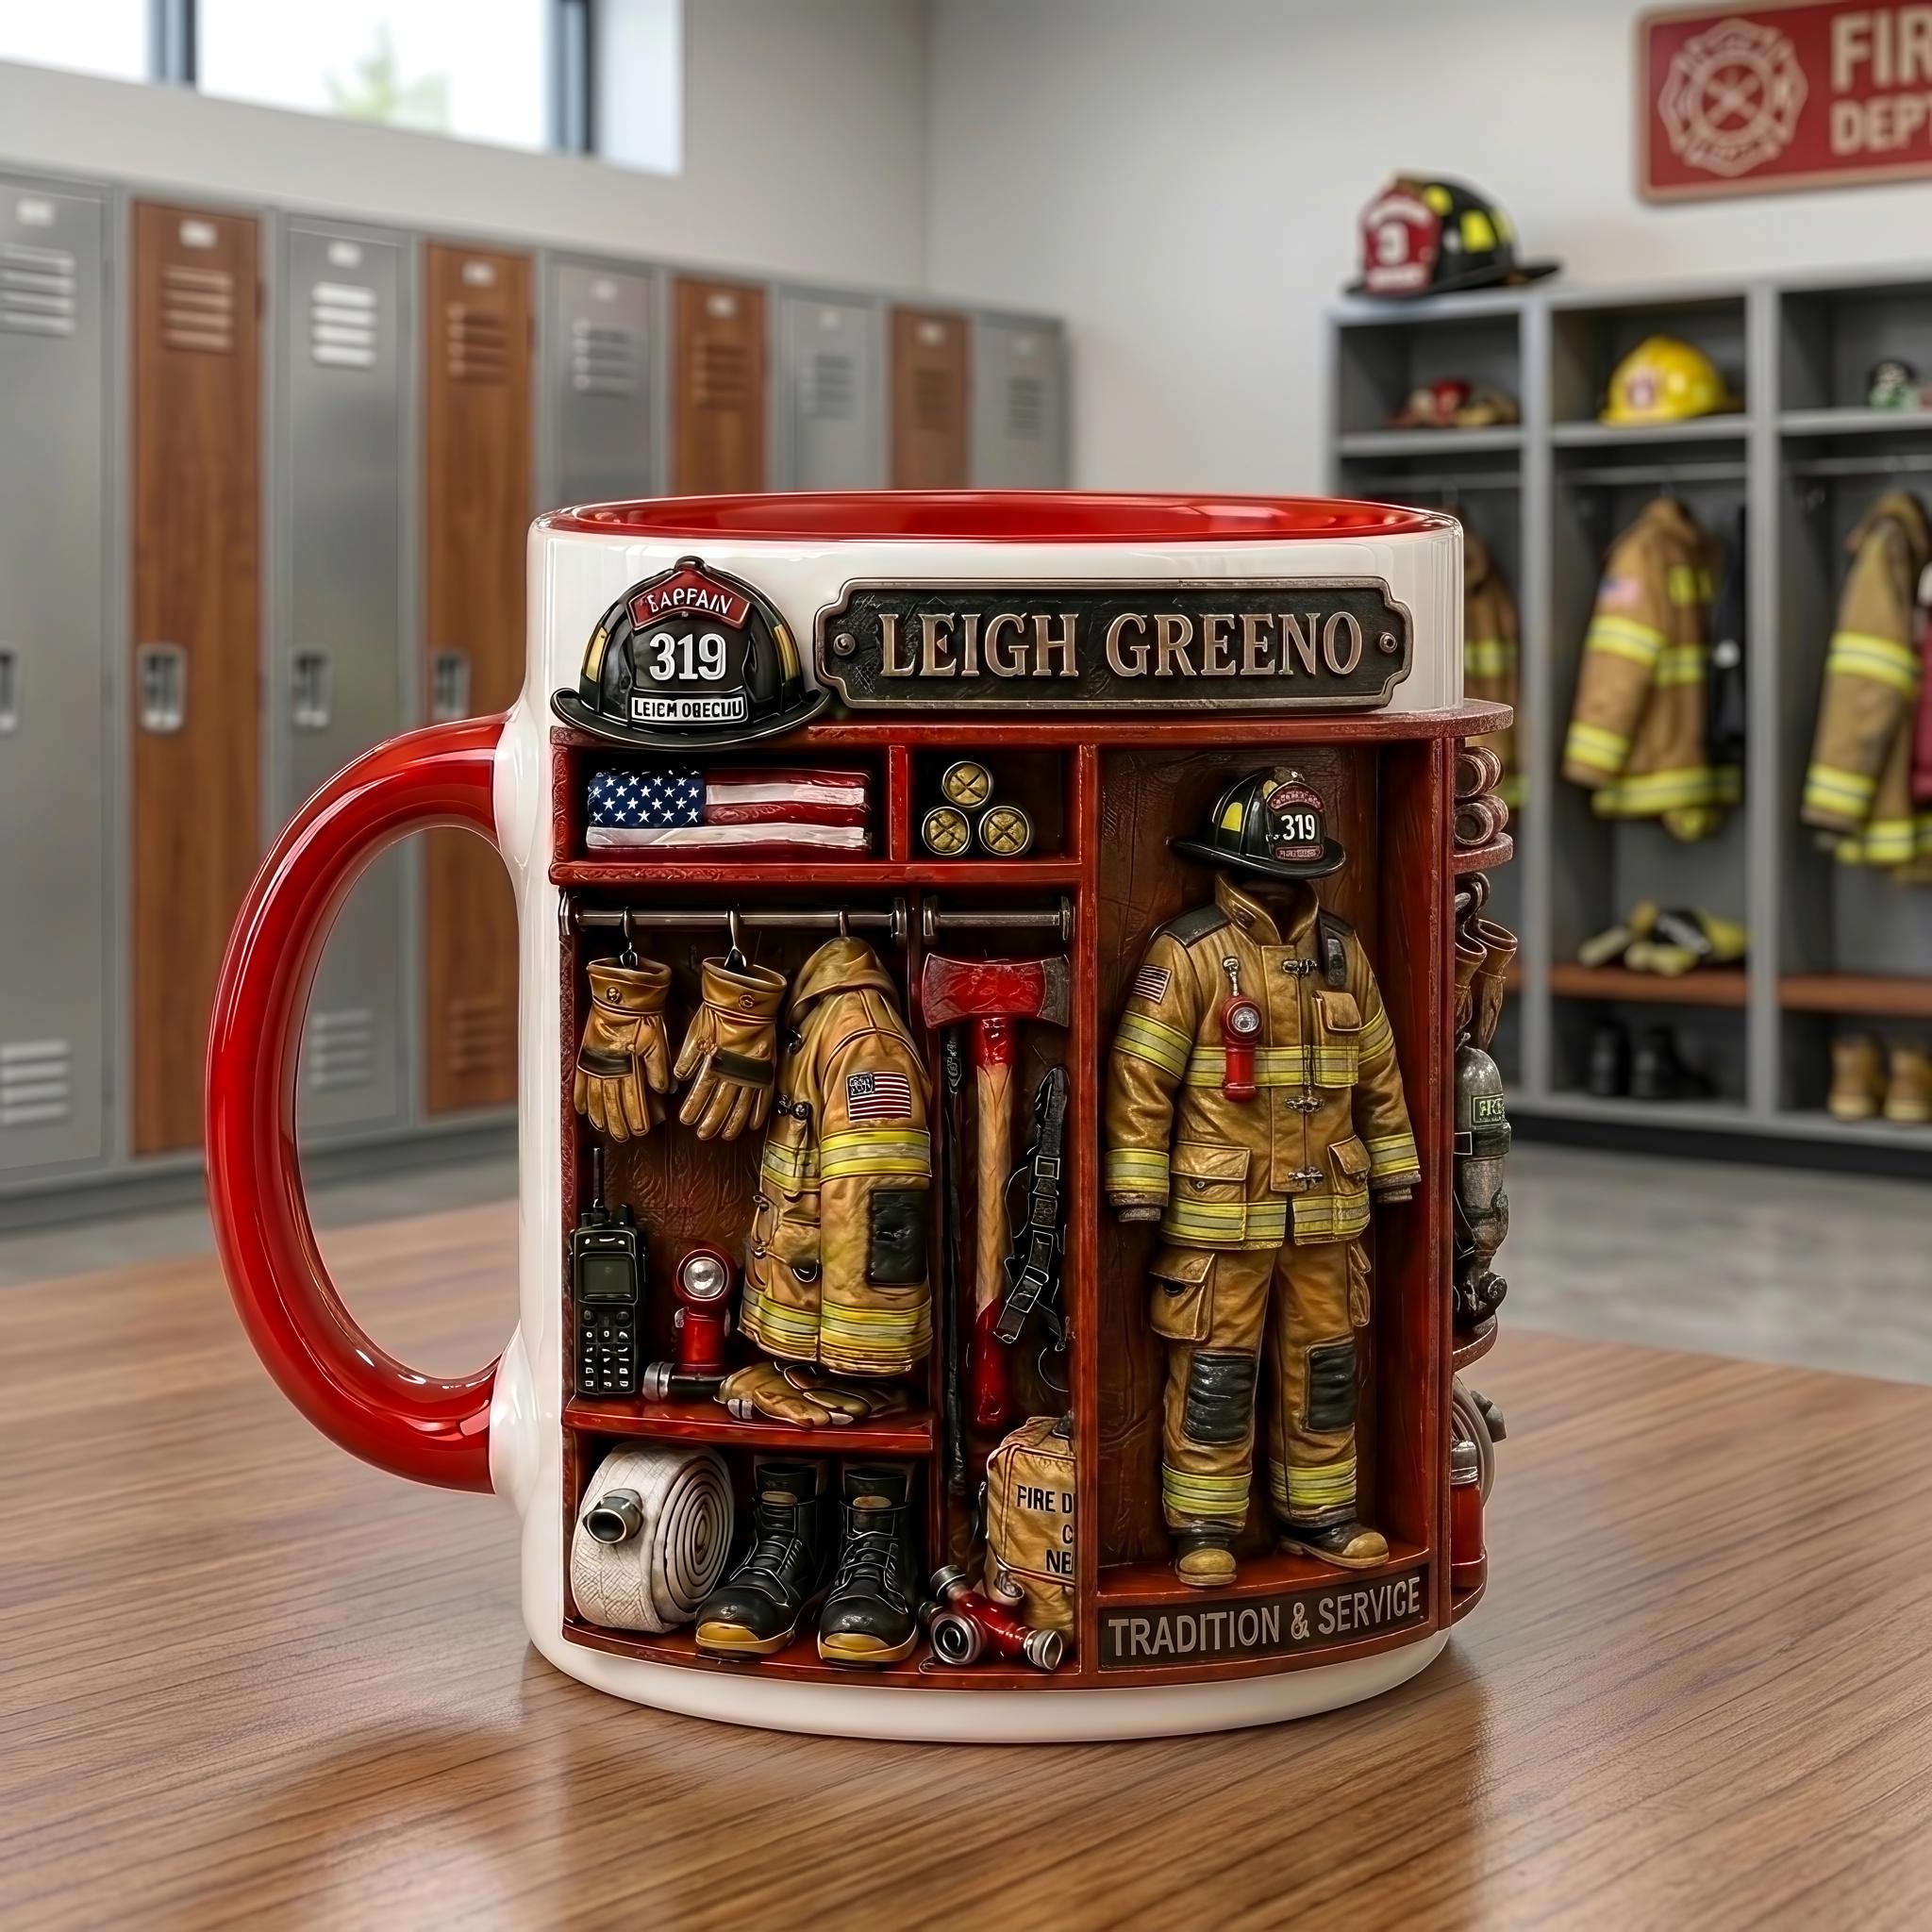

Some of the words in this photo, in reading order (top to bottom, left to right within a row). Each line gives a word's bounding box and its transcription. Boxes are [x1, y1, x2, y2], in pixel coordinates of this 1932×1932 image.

[1830, 92, 1932, 157] DEP
[649, 632, 726, 680] 319
[877, 611, 1080, 678] LEIGH
[1106, 609, 1364, 678] GREENO
[1280, 814, 1316, 841] 319
[1017, 1484, 1057, 1513] FIRE
[1108, 1605, 1280, 1657] TRADITION
[1290, 1602, 1310, 1640] &
[1318, 1576, 1421, 1636] SERVICE
